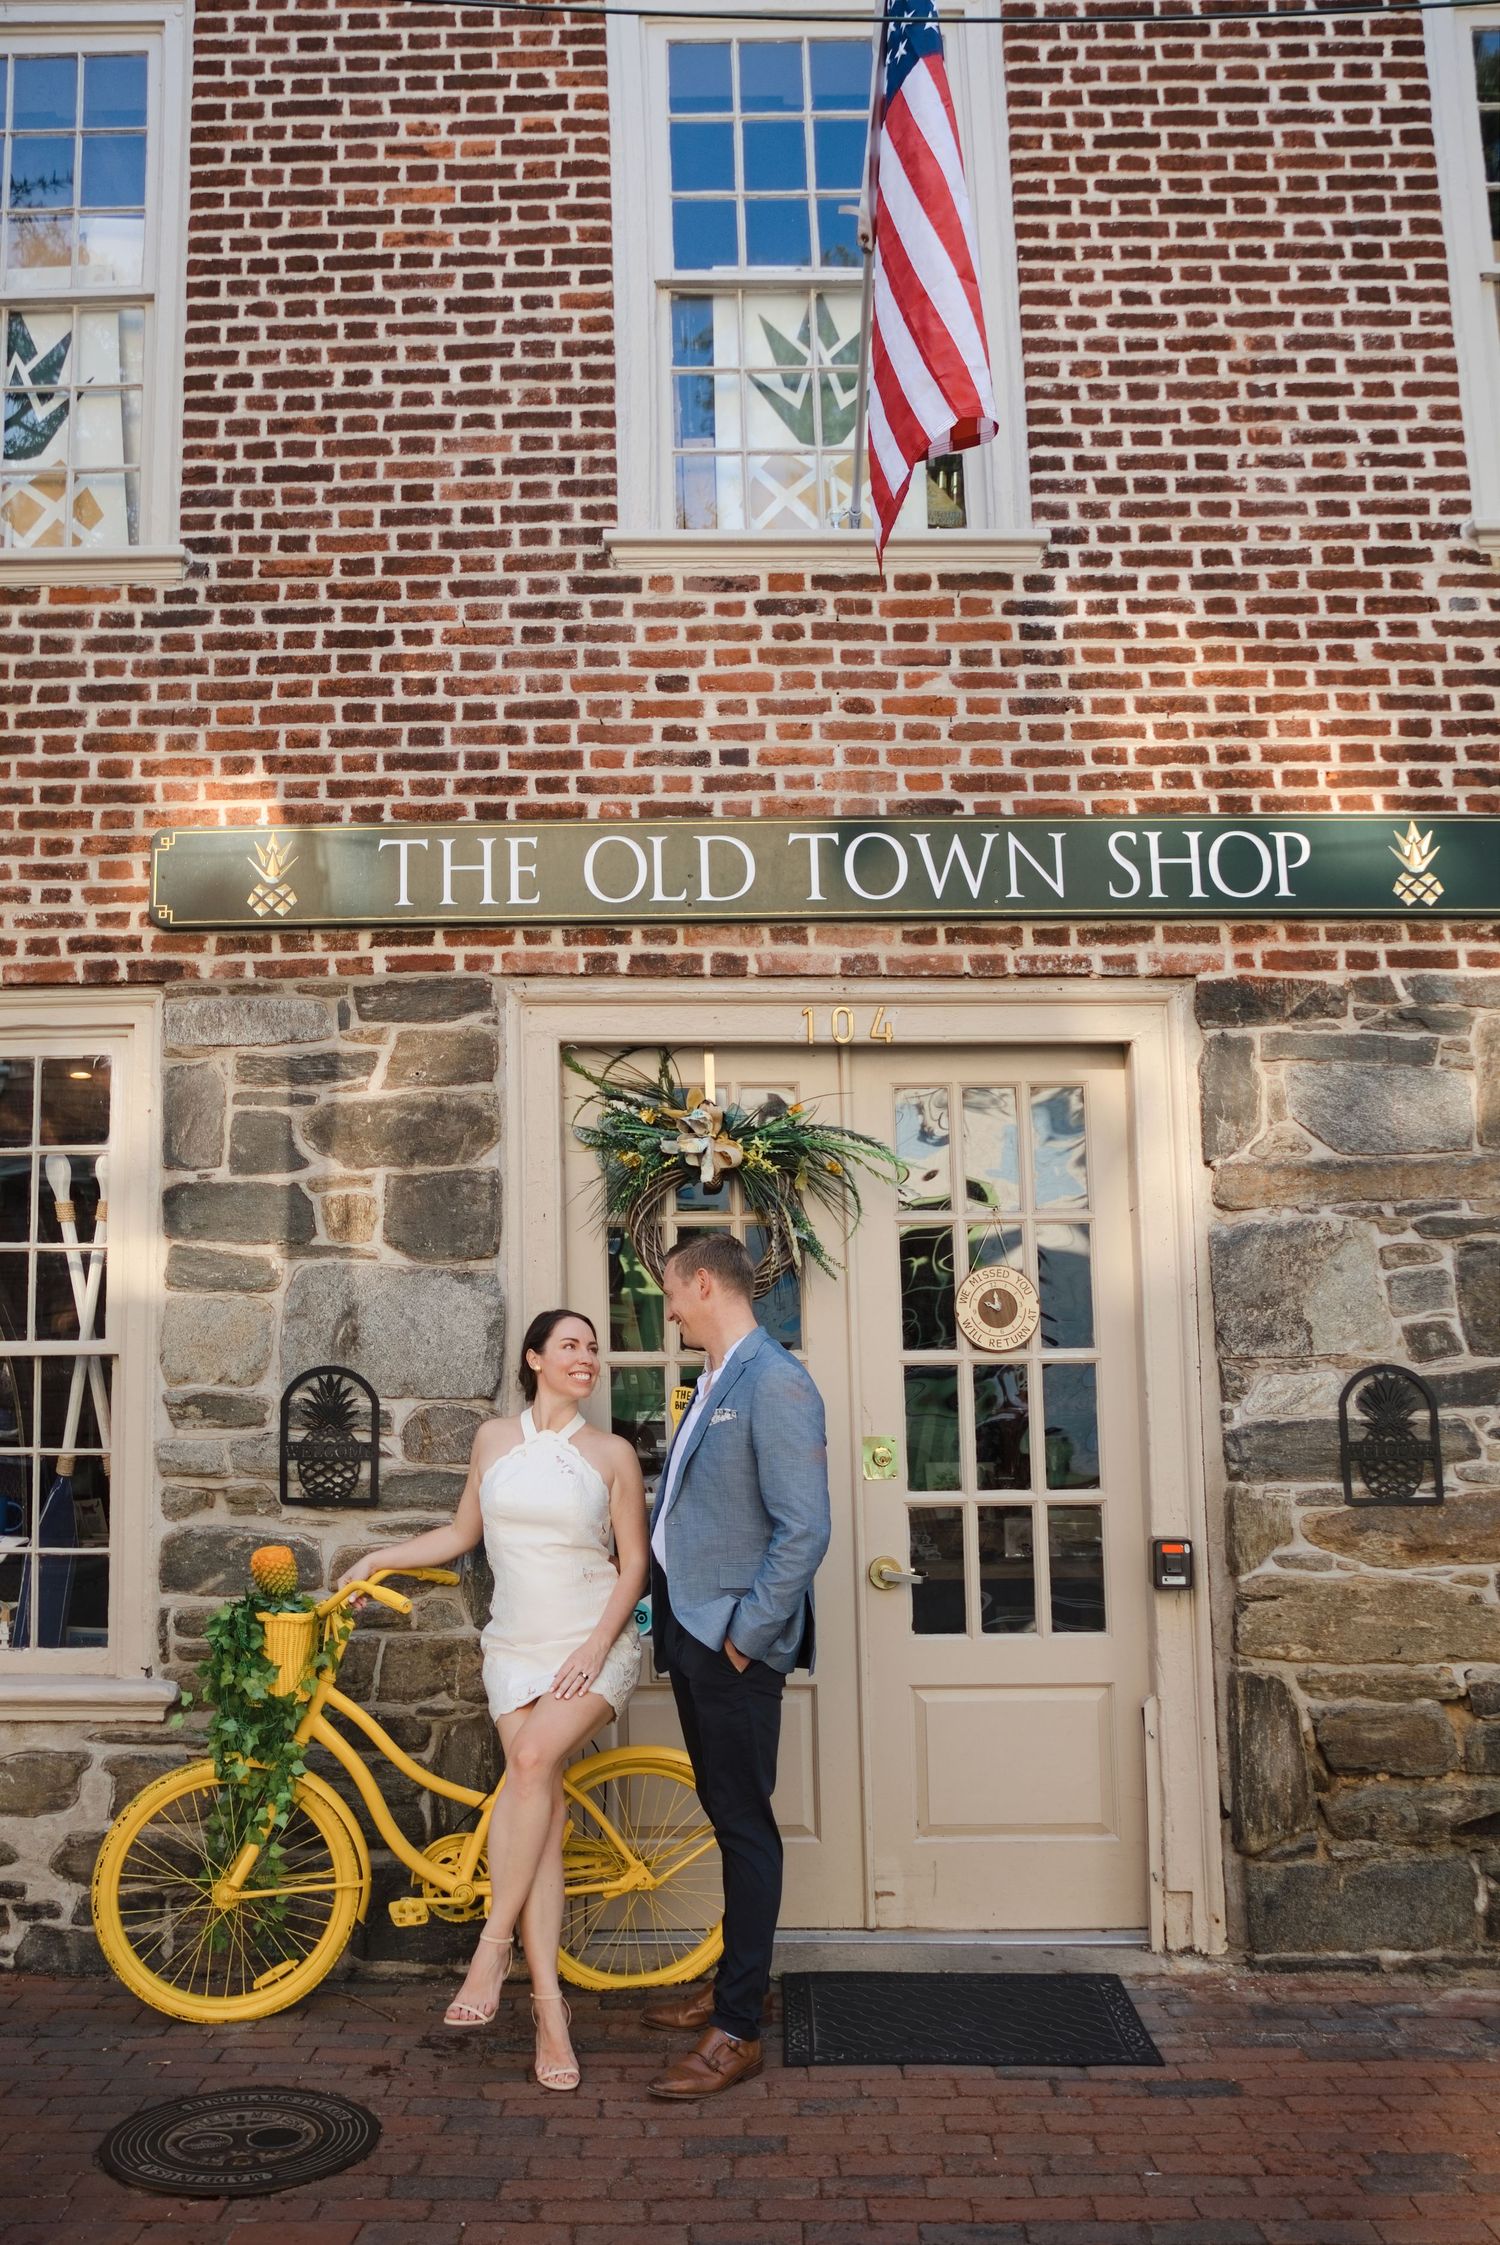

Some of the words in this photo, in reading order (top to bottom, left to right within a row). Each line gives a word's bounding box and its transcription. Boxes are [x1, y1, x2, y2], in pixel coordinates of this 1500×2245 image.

[378, 835, 541, 906] THE
[583, 834, 756, 904] OLD
[786, 830, 1067, 902] TOWN
[1107, 829, 1312, 900] SHOP
[802, 1006, 893, 1044] 104
[959, 1289, 971, 1304] WE
[969, 1269, 1010, 1287] MISSED
[1014, 1276, 1033, 1296] YOU
[962, 1318, 982, 1344] WILL
[988, 1325, 1031, 1348] RETURN
[1027, 1308, 1037, 1322] AT
[675, 1389, 691, 1401] THE
[675, 1401, 688, 1411] BIK
[285, 1444, 376, 1458] WELCOME
